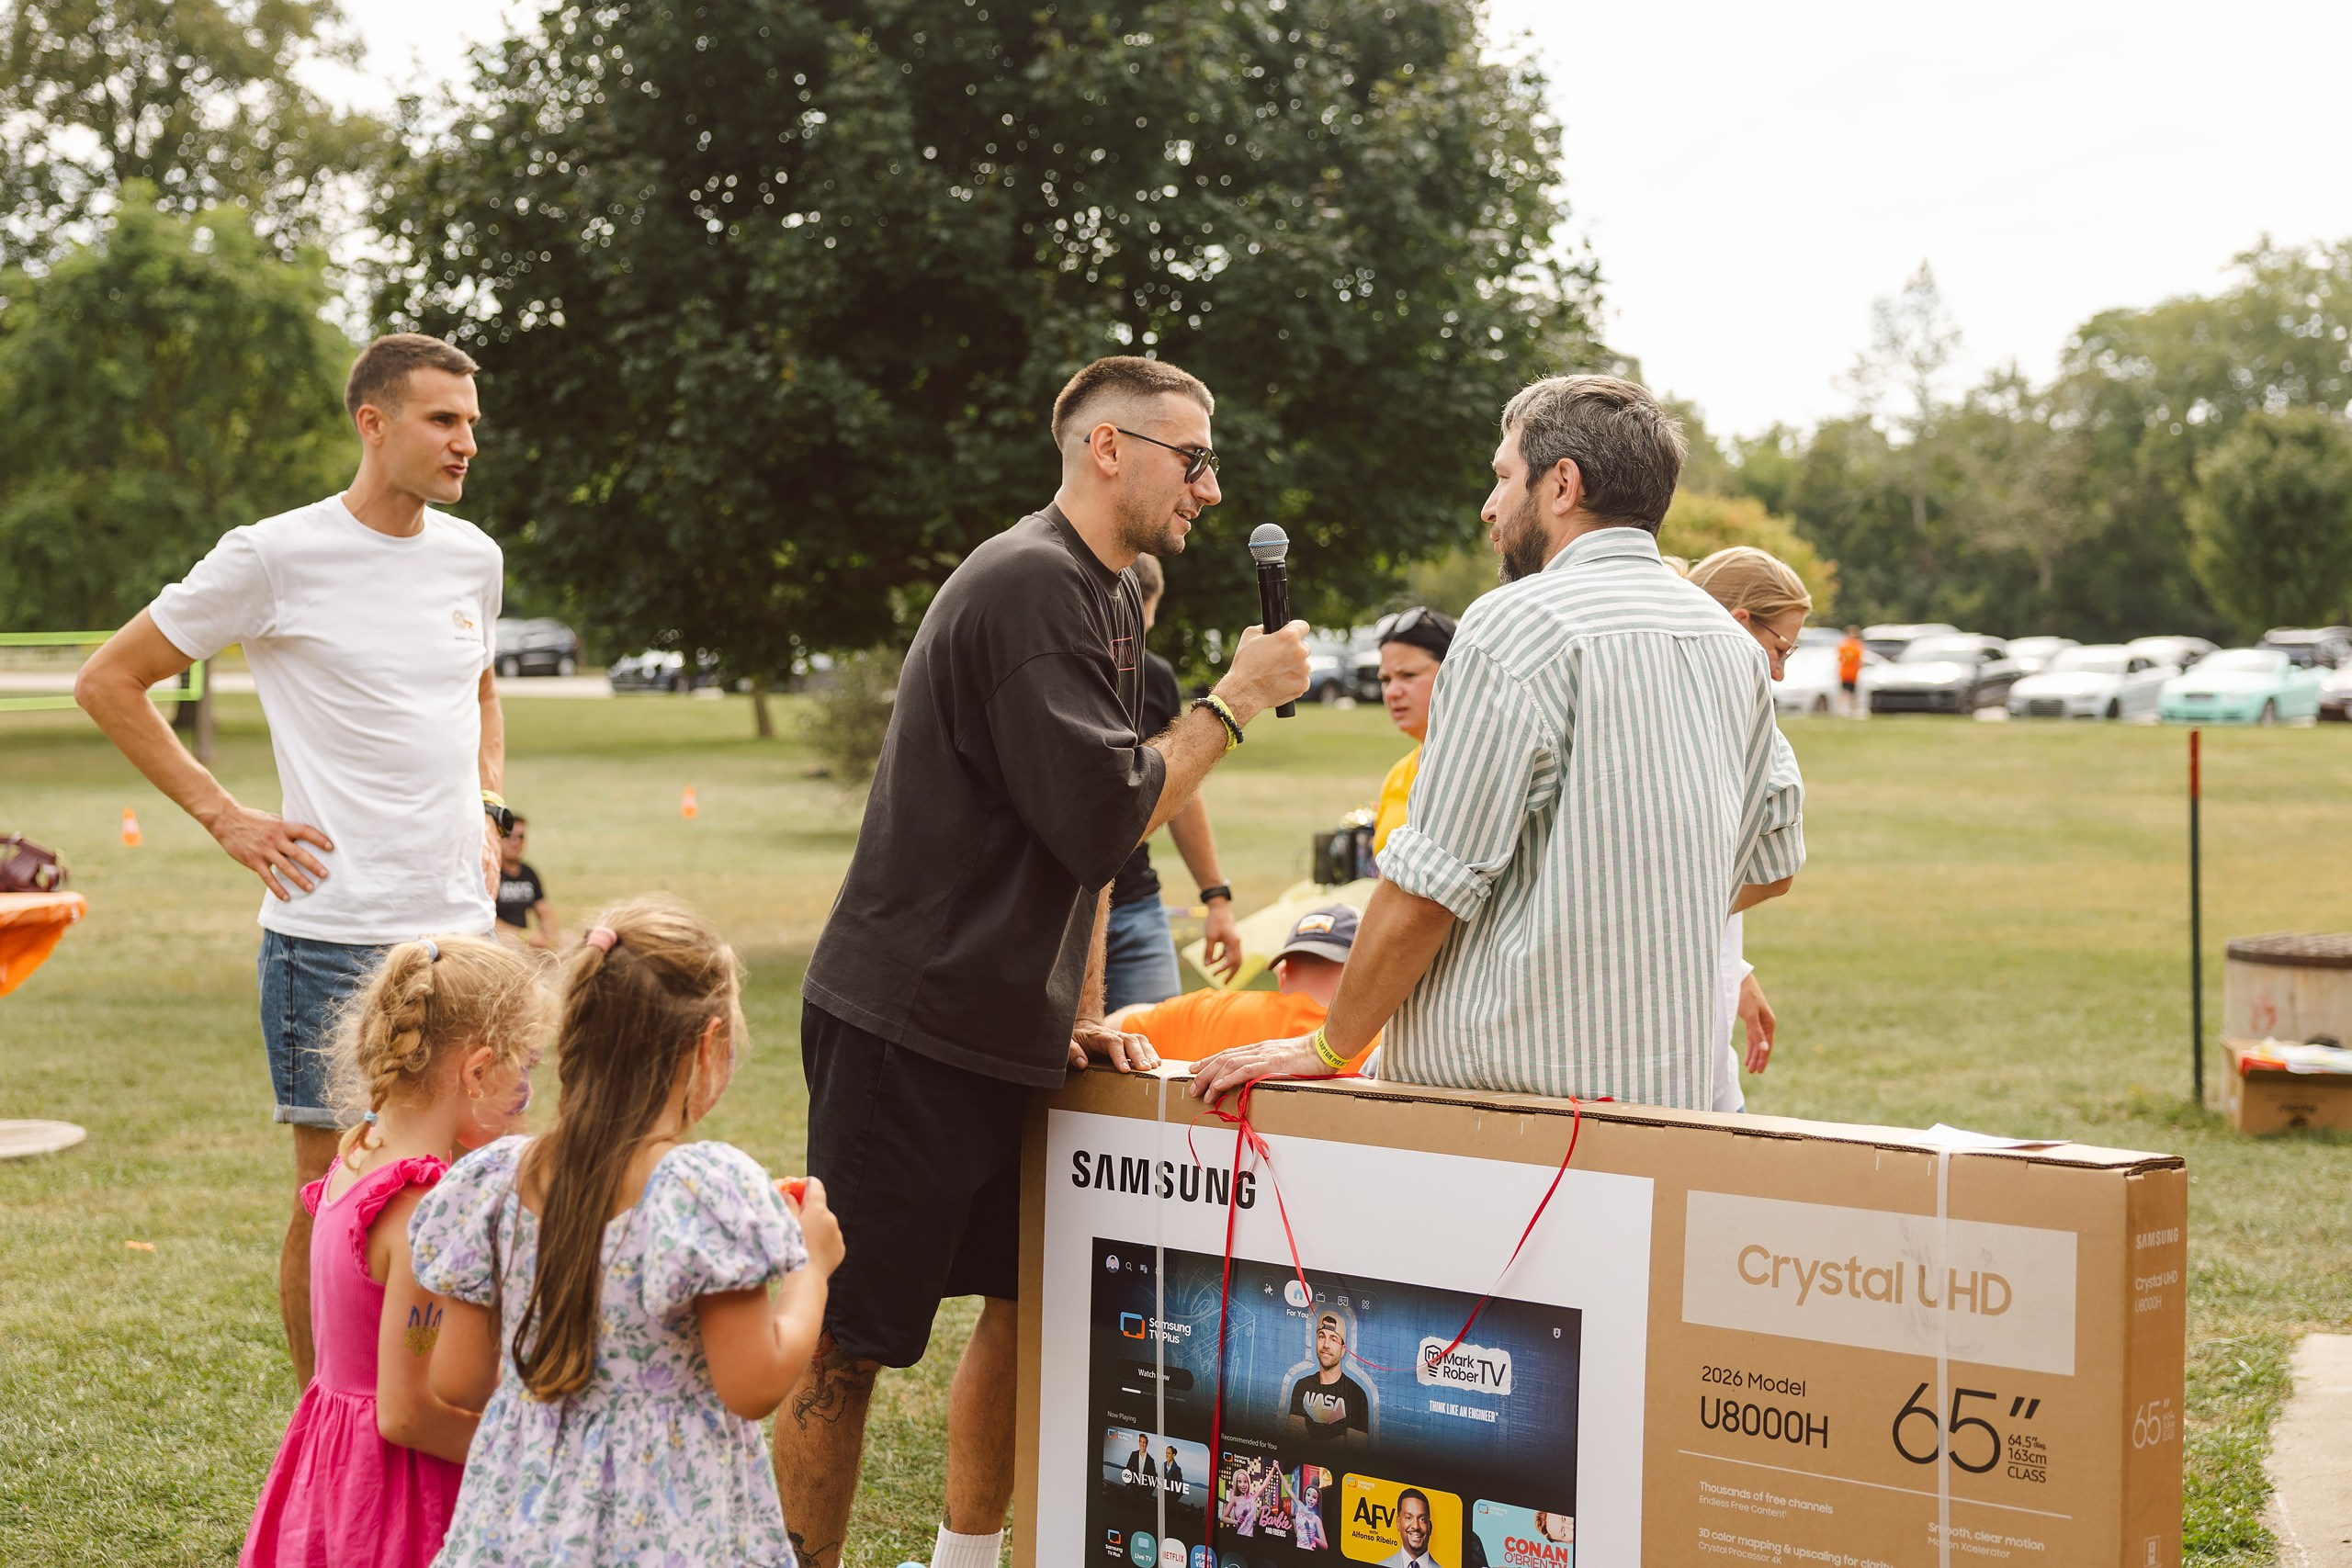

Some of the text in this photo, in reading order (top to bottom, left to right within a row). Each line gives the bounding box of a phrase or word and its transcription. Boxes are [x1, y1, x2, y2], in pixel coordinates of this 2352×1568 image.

[1072, 1150, 1256, 1210] SAMSUNG
[2135, 1228, 2178, 1249] SAMSUNG
[1737, 1244, 2012, 1316] Crystal UHD
[2136, 1269, 2178, 1293] Crystal UHD
[1286, 1309, 1309, 1318] For You
[1444, 1353, 1475, 1369] Mark
[1137, 1368, 1156, 1379] Watch
[1443, 1366, 1479, 1383] Rober
[1477, 1359, 1507, 1387] TV
[1702, 1365, 1806, 1397] 2026 Model
[1303, 1391, 1347, 1417] NASA
[1429, 1400, 1446, 1415] THINK
[1446, 1403, 1459, 1416] LIKE
[1459, 1405, 1468, 1418] AN
[1701, 1395, 1829, 1450] U8000H
[1220, 1433, 1278, 1450] Recommended for You
[2007, 1447, 2047, 1465] 163cm
[2007, 1465, 2047, 1483] CLASS
[1163, 1478, 1190, 1495] LIVE
[1699, 1495, 1730, 1509] Endless
[1730, 1500, 1750, 1513] Free
[1700, 1481, 1834, 1515] Thousands of free channels
[1259, 1505, 1293, 1530] Barbie
[1352, 1496, 1396, 1530] AFV
[1351, 1530, 1398, 1547] Alfonso Ribeiro
[1698, 1528, 1894, 1568] 3D color mapping & upscaling for clarit
[1928, 1537, 2011, 1559] Moon Xcelerator
[1973, 1530, 2004, 1545] clear
[2005, 1537, 2045, 1552] motion
[1161, 1551, 1185, 1564] NETFLIX
[1504, 1536, 1568, 1564] CONAN
[1698, 1541, 1782, 1565] Crystal Processor 4K
